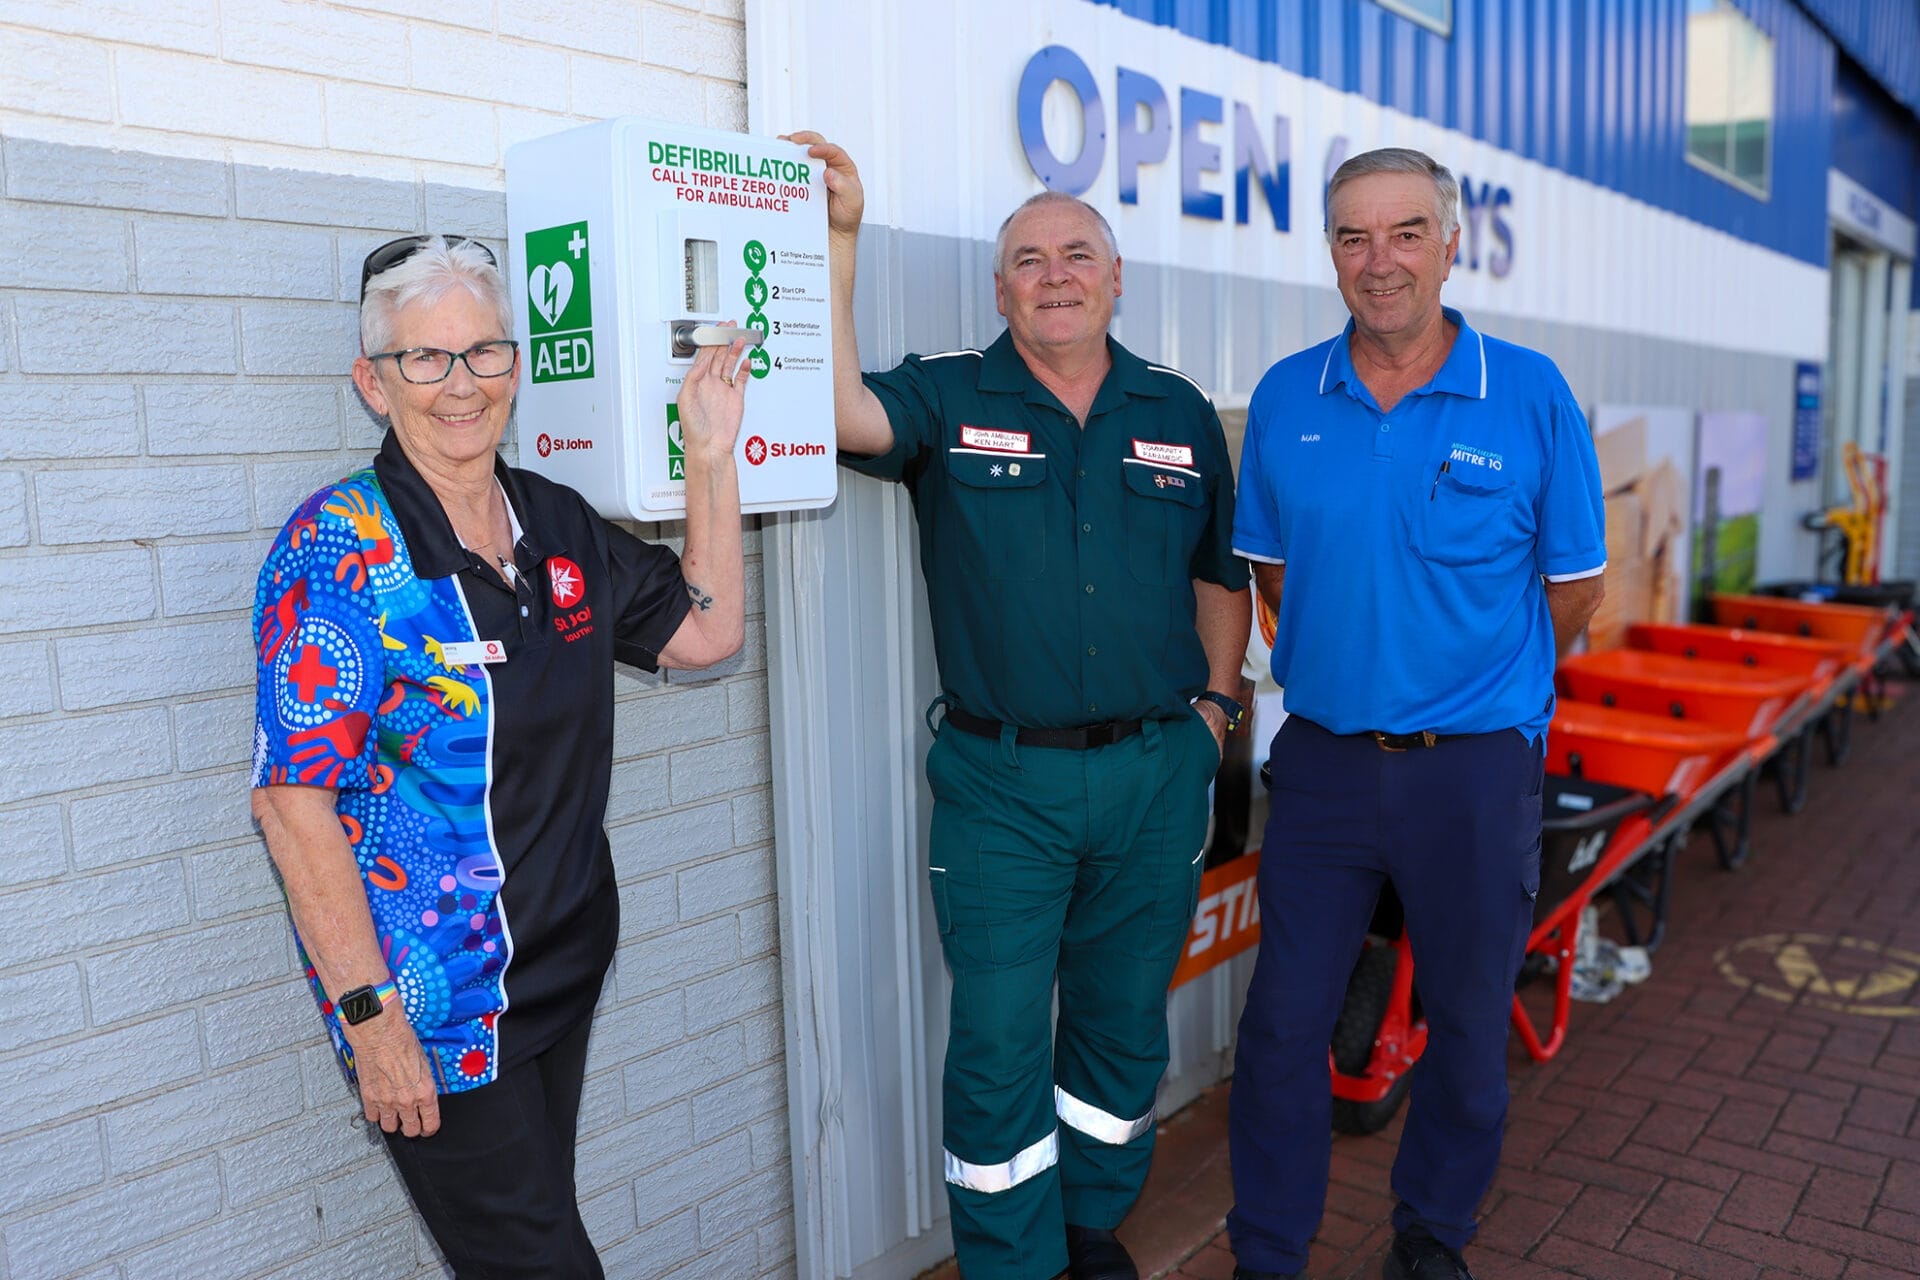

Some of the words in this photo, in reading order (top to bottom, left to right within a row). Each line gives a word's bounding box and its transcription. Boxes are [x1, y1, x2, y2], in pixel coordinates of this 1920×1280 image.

[1018, 44, 1291, 233] OPEN
[648, 141, 810, 184] DEFIBRILLATOR
[652, 168, 688, 184] CALL
[692, 172, 738, 191] TRIPLE
[742, 179, 776, 195] ZERO
[779, 184, 809, 201] (000)
[676, 187, 704, 202] FOR
[708, 191, 789, 212] AMBULANCE
[1452, 174, 1514, 279] YS
[770, 250, 776, 265] 1
[772, 285, 780, 300] 2
[773, 321, 781, 335] 3
[535, 338, 592, 377] AED
[774, 356, 782, 370] 4
[554, 439, 564, 450] St
[566, 438, 592, 450] John
[771, 443, 786, 457] St
[789, 443, 826, 456] John
[1450, 449, 1486, 466] MITRE
[1488, 458, 1502, 471] 10
[1188, 876, 1261, 958] STI
